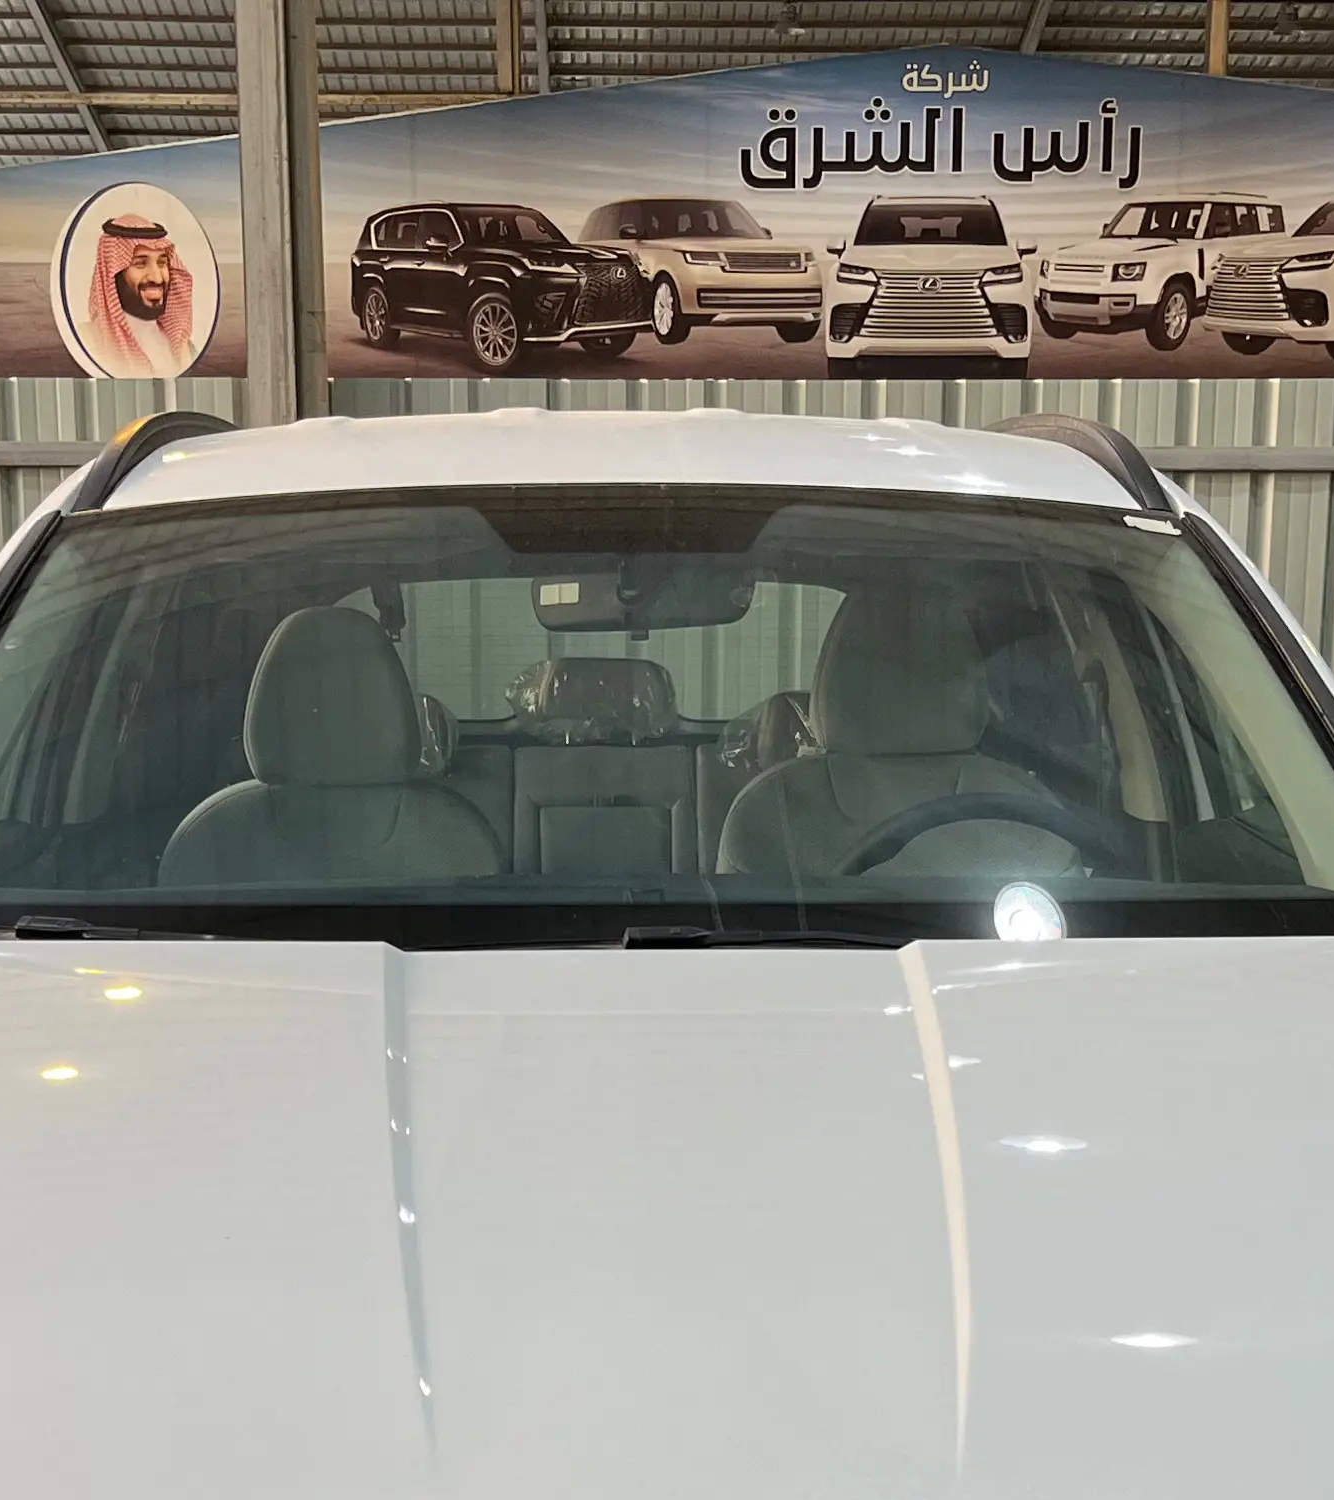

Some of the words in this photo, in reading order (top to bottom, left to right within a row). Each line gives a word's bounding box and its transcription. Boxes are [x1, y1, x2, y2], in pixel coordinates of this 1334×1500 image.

[901, 59, 992, 98] شركة
[738, 97, 966, 190] الشرق
[989, 97, 1144, 190] رأس
